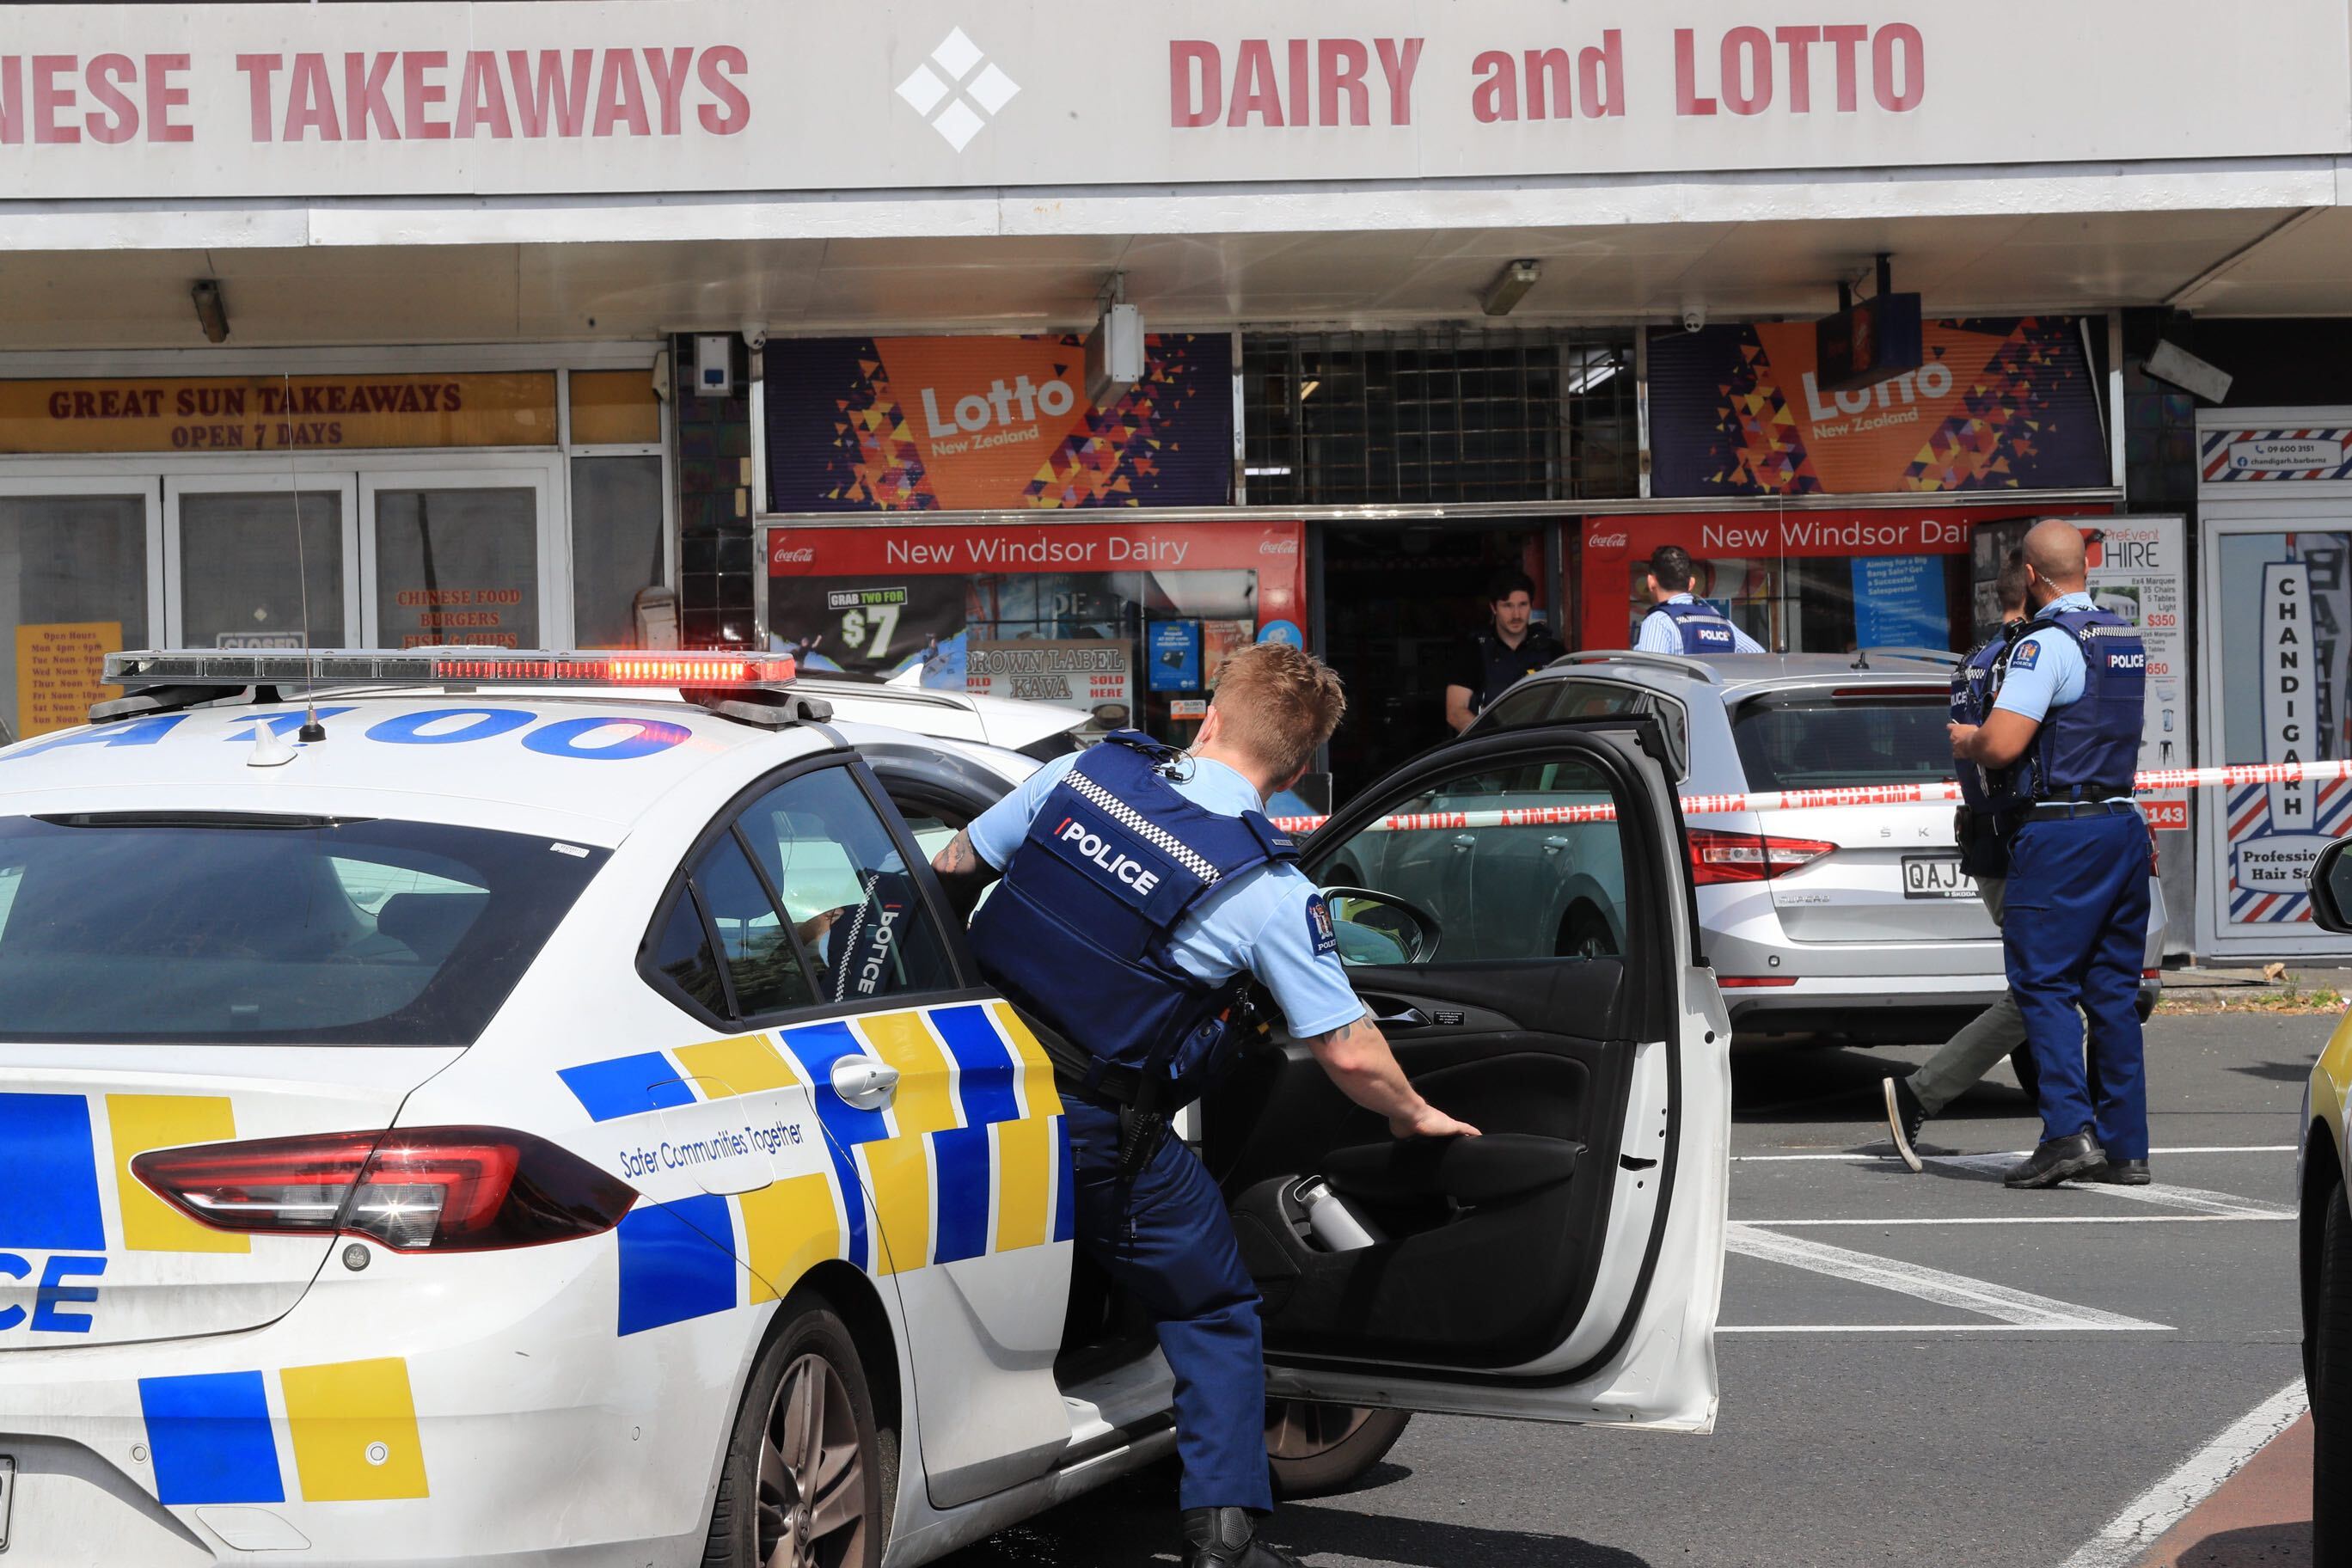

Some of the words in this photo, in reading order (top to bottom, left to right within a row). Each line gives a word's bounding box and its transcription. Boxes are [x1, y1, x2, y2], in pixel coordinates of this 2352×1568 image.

[1169, 38, 1424, 128] DAIRY
[1472, 28, 1626, 123] and
[1674, 22, 1925, 117] LOTTO
[236, 46, 750, 143] TAKEAWAYS
[48, 389, 164, 420] GREAT
[176, 387, 246, 417] SUN
[260, 383, 462, 414] TAKEAWAYS
[922, 375, 1074, 438] Lotto
[1812, 424, 1849, 440] New
[1853, 407, 1920, 432] Zealand
[171, 424, 243, 448] OPEN
[255, 424, 266, 448] 7
[276, 421, 342, 445] DAYS
[931, 439, 968, 456] New
[971, 424, 1039, 450] Zealand
[1702, 524, 1769, 548] New
[1781, 521, 1909, 547] Windsor
[1920, 519, 1969, 544] Dai
[2104, 528, 2159, 541] PreEvent
[886, 539, 954, 565] New
[966, 536, 1098, 563] Windsor
[1108, 536, 1189, 566] Dairy
[2105, 541, 2159, 568] HIRE
[2146, 577, 2176, 585] Marquee
[397, 590, 471, 606] CHINESE
[476, 588, 522, 603] FOOD
[830, 593, 859, 606] GRAB
[861, 591, 882, 603] TWO
[884, 591, 903, 602] FOR
[420, 611, 499, 628] BURGERS
[2147, 613, 2176, 627] $350
[842, 604, 900, 658] $7
[1700, 629, 1730, 641] POLICE
[403, 634, 444, 649] FISH
[466, 633, 518, 649] CHIPS
[1047, 647, 1125, 673] LABEL
[2110, 654, 2144, 668] POLICE
[2147, 663, 2168, 675] 650
[966, 677, 991, 688] OLD
[1010, 675, 1073, 700] KAVA
[1089, 675, 1124, 685] SOLD
[1089, 688, 1124, 698] HERE
[2146, 806, 2184, 823] 143
[1061, 821, 1160, 896] POLICE
[2243, 848, 2318, 863] Professio
[2251, 867, 2288, 880] Hair
[1779, 894, 1830, 903] SUPERB
[620, 1147, 660, 1179] Safer
[660, 1129, 749, 1169] Communities
[744, 1120, 805, 1155] Together
